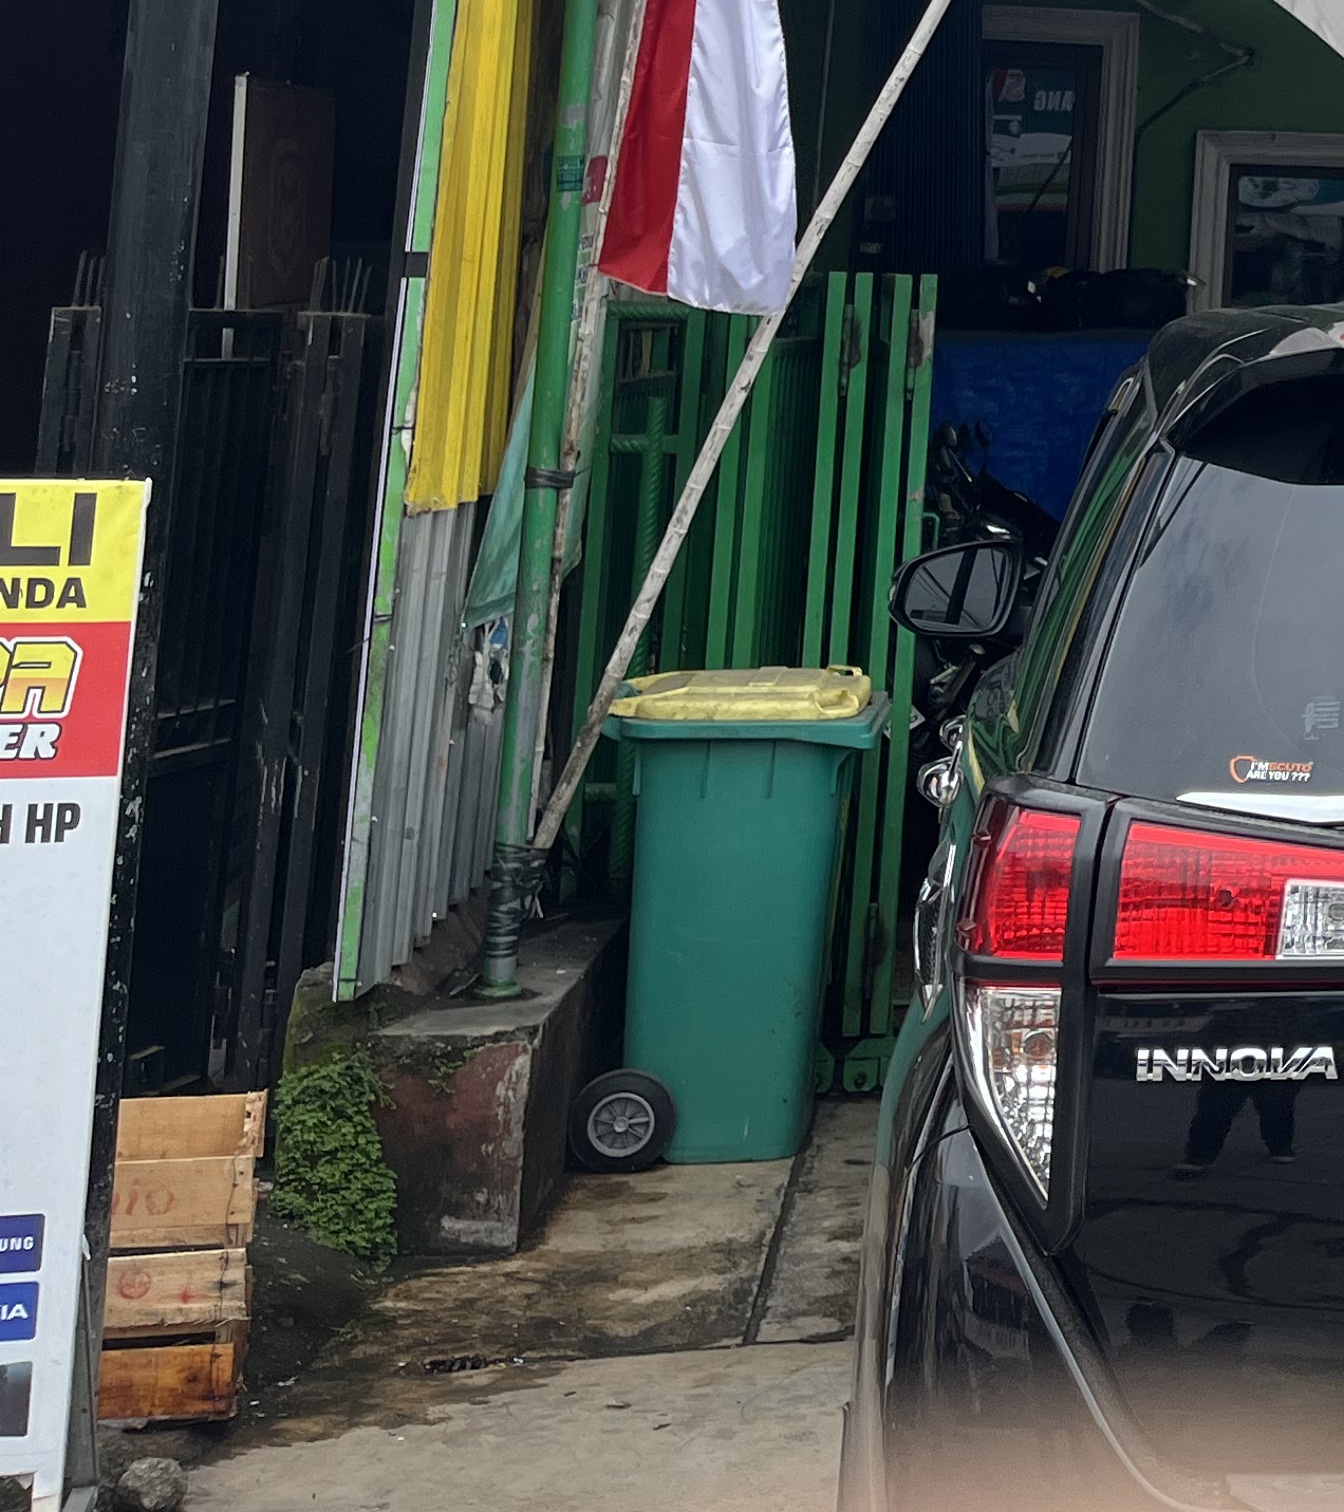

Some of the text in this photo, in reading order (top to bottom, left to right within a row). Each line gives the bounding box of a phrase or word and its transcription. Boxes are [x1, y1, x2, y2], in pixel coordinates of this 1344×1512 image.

[1268, 770, 1290, 782] YOU
[24, 801, 82, 844] HP
[1135, 1045, 1340, 1083] INNOVA
